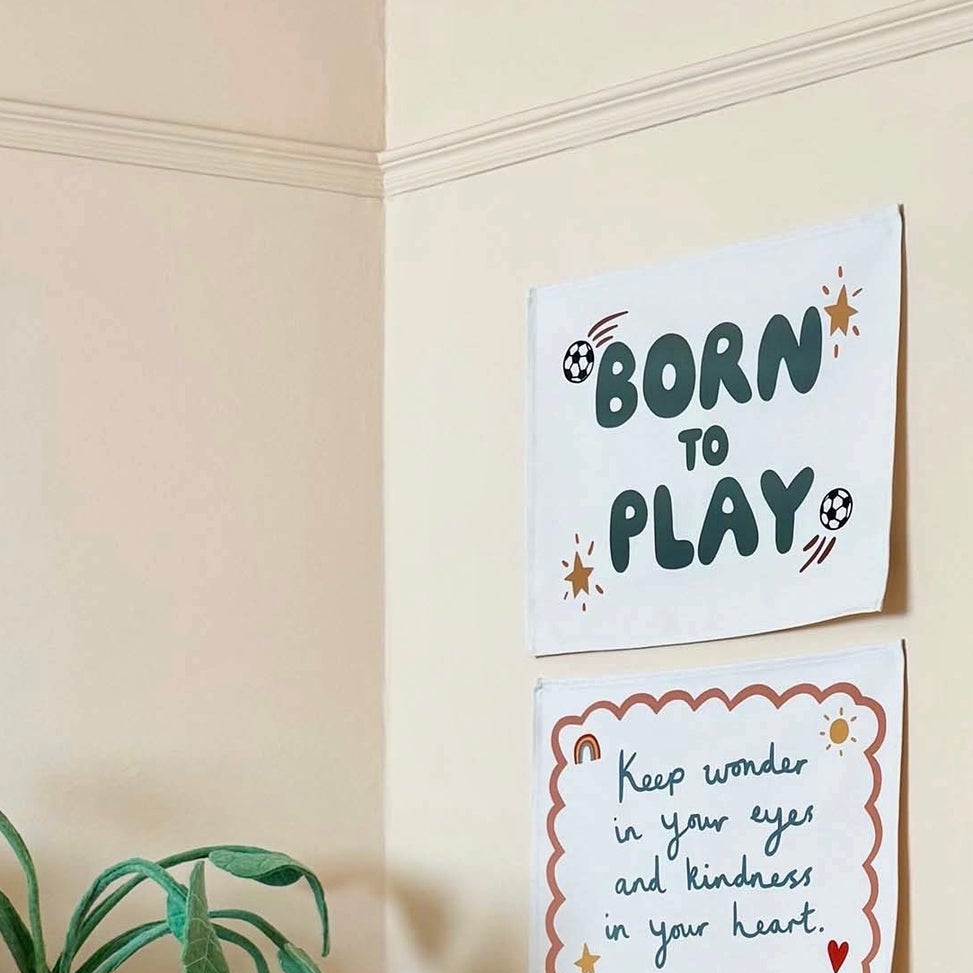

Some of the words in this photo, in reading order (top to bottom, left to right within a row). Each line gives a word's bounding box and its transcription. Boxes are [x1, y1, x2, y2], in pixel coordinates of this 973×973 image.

[595, 306, 822, 428] BORN
[678, 425, 729, 471] TO
[609, 467, 815, 573] PLAY
[618, 749, 685, 804] Keep
[703, 742, 808, 785] wonder
[613, 817, 642, 843] in
[661, 812, 729, 860] your
[750, 804, 814, 857] eyes
[615, 855, 666, 896] and
[686, 854, 813, 890] kindness
[605, 913, 630, 940] in
[649, 918, 709, 969] your
[732, 901, 825, 938] heart.
